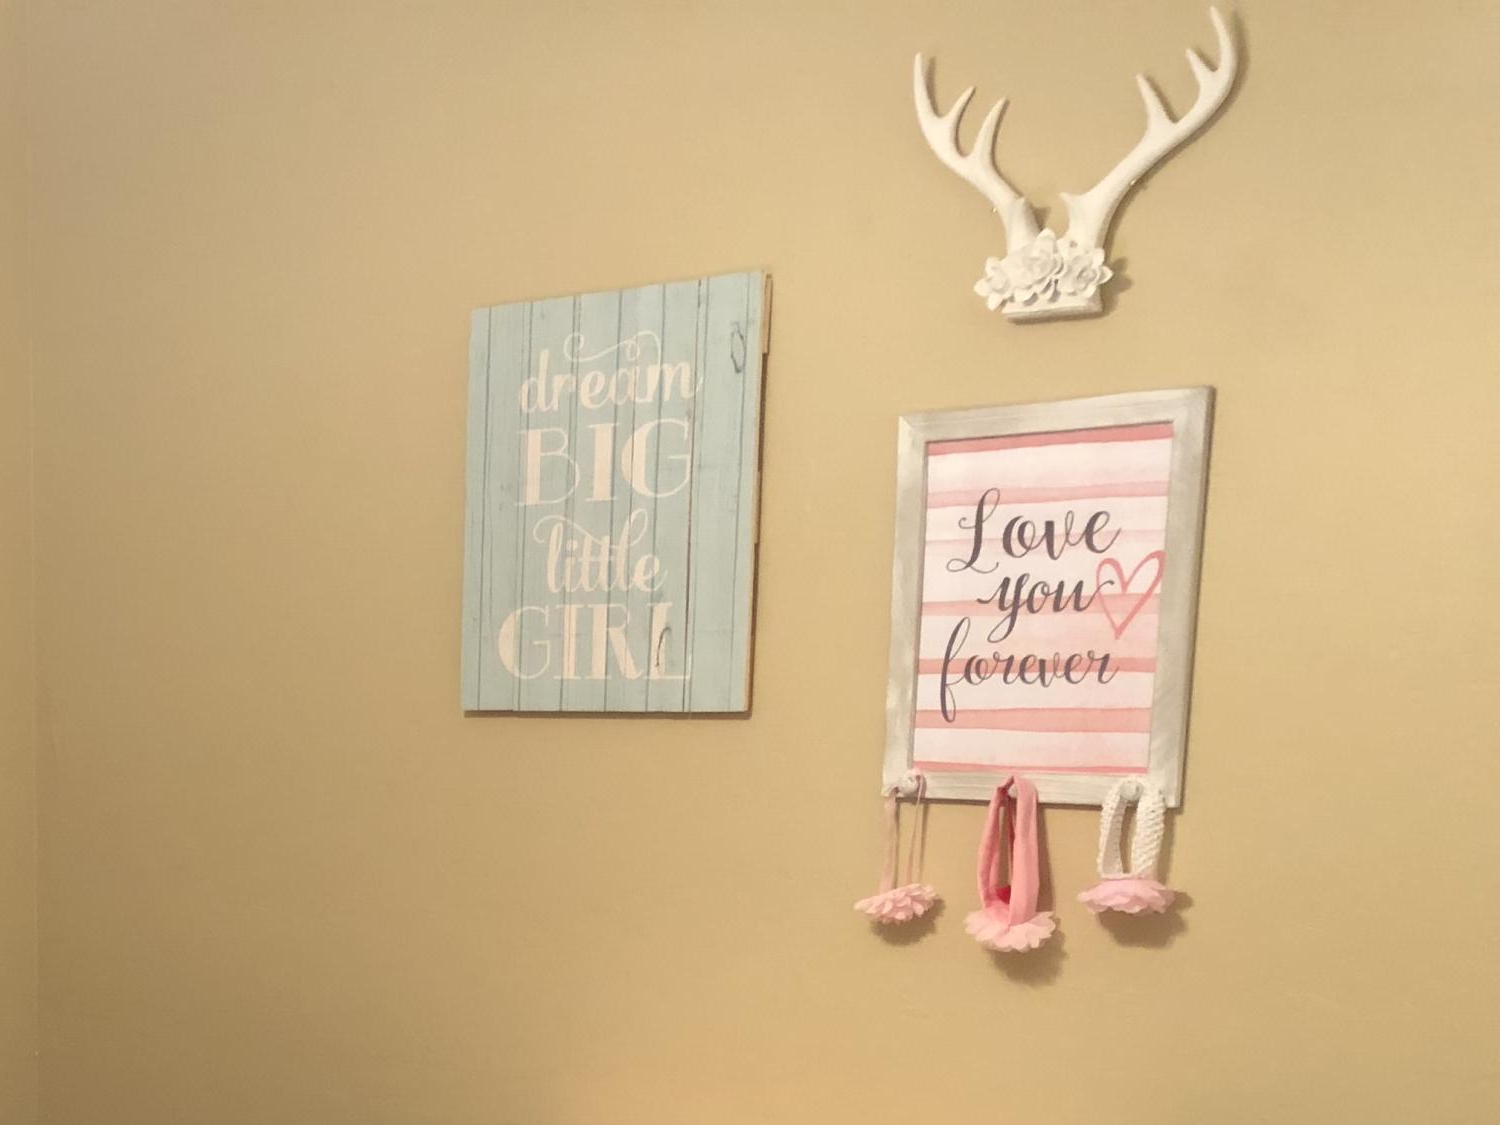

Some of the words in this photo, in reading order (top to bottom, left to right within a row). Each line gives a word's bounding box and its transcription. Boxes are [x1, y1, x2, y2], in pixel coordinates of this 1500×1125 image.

[520, 330, 703, 413] dream
[516, 418, 692, 506] BIG
[533, 508, 669, 593] little
[946, 487, 1122, 573] Love
[499, 602, 691, 681] GIRL
[976, 573, 1115, 643] you
[940, 617, 1119, 723] forever
